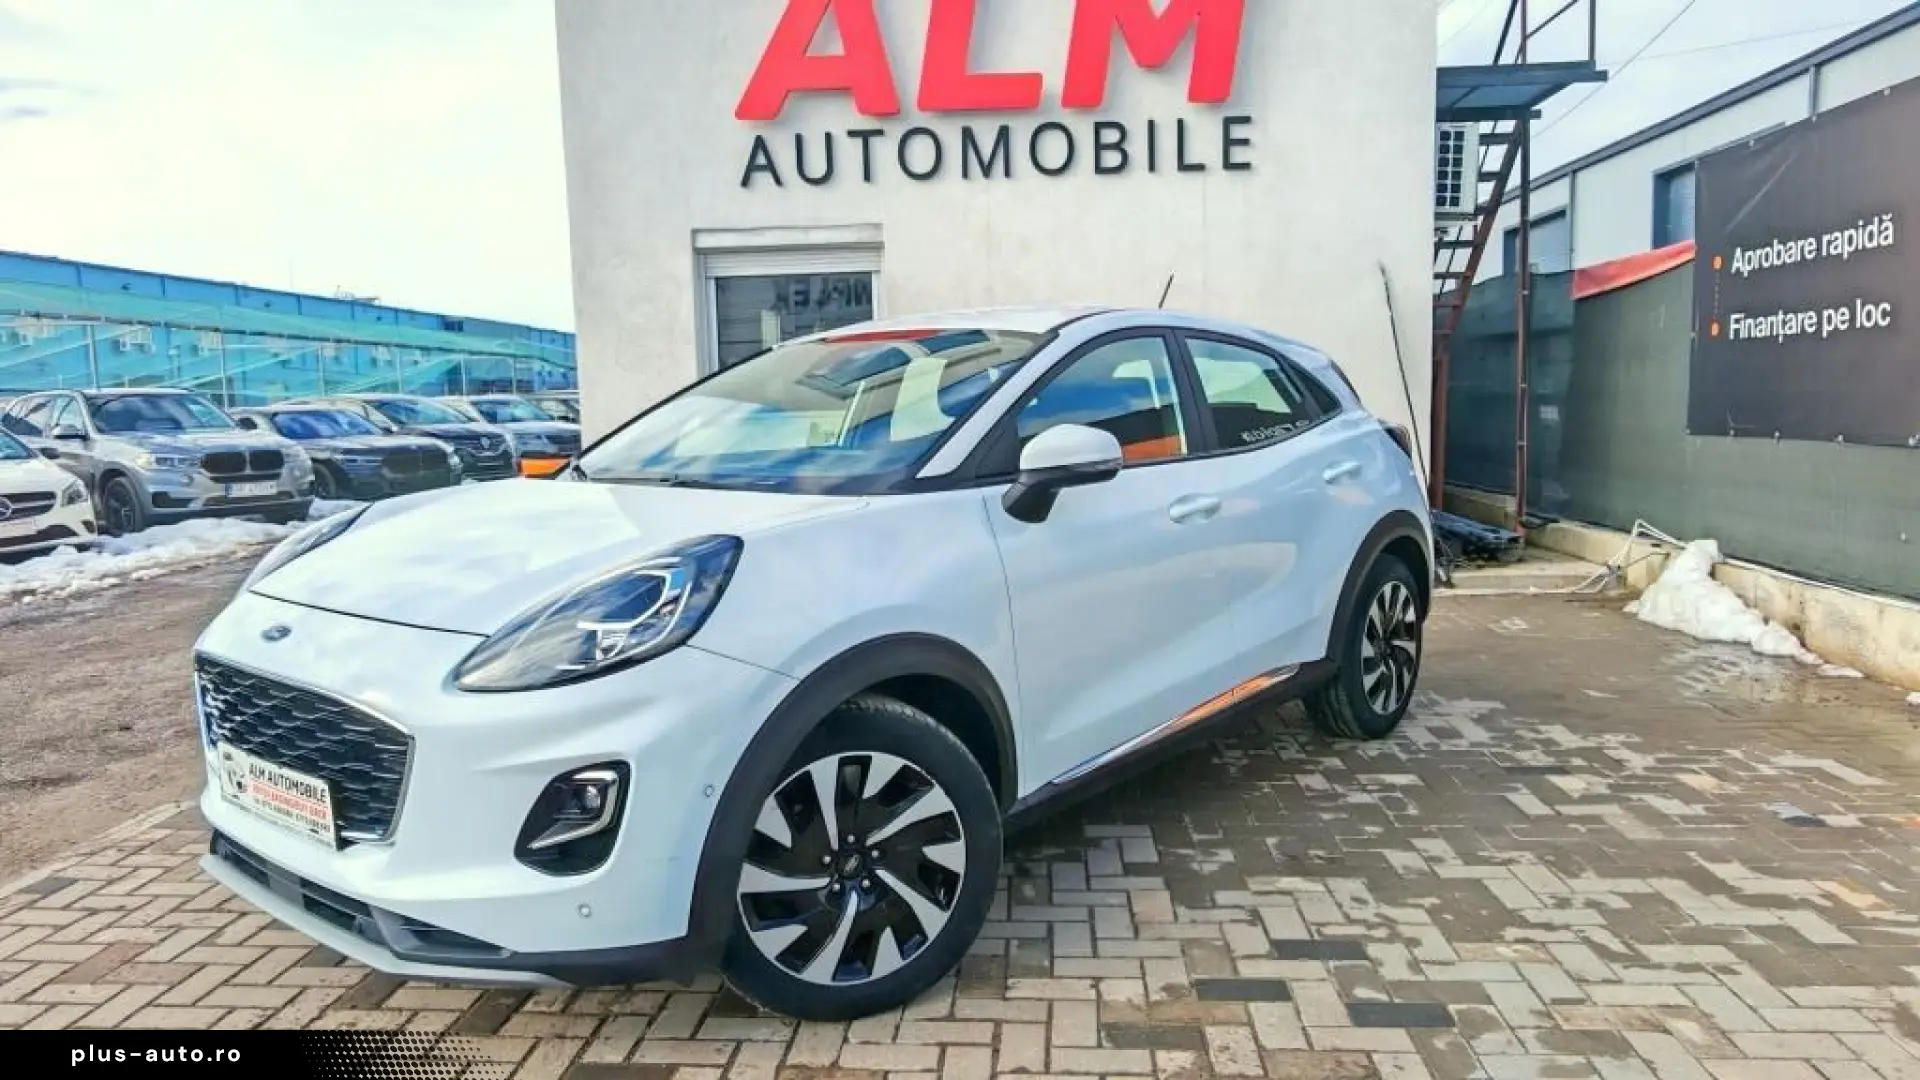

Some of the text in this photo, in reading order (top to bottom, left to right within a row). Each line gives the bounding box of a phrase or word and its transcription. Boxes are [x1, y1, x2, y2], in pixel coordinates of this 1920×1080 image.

[735, 0, 1245, 120] ALM
[740, 116, 1253, 188] AUTOMOBILE
[1731, 213, 1895, 277] Aprobare rapidă
[1729, 298, 1891, 344] Finanțare pe loc
[249, 763, 266, 781] ALM
[267, 769, 327, 803] AUTOMOBILE
